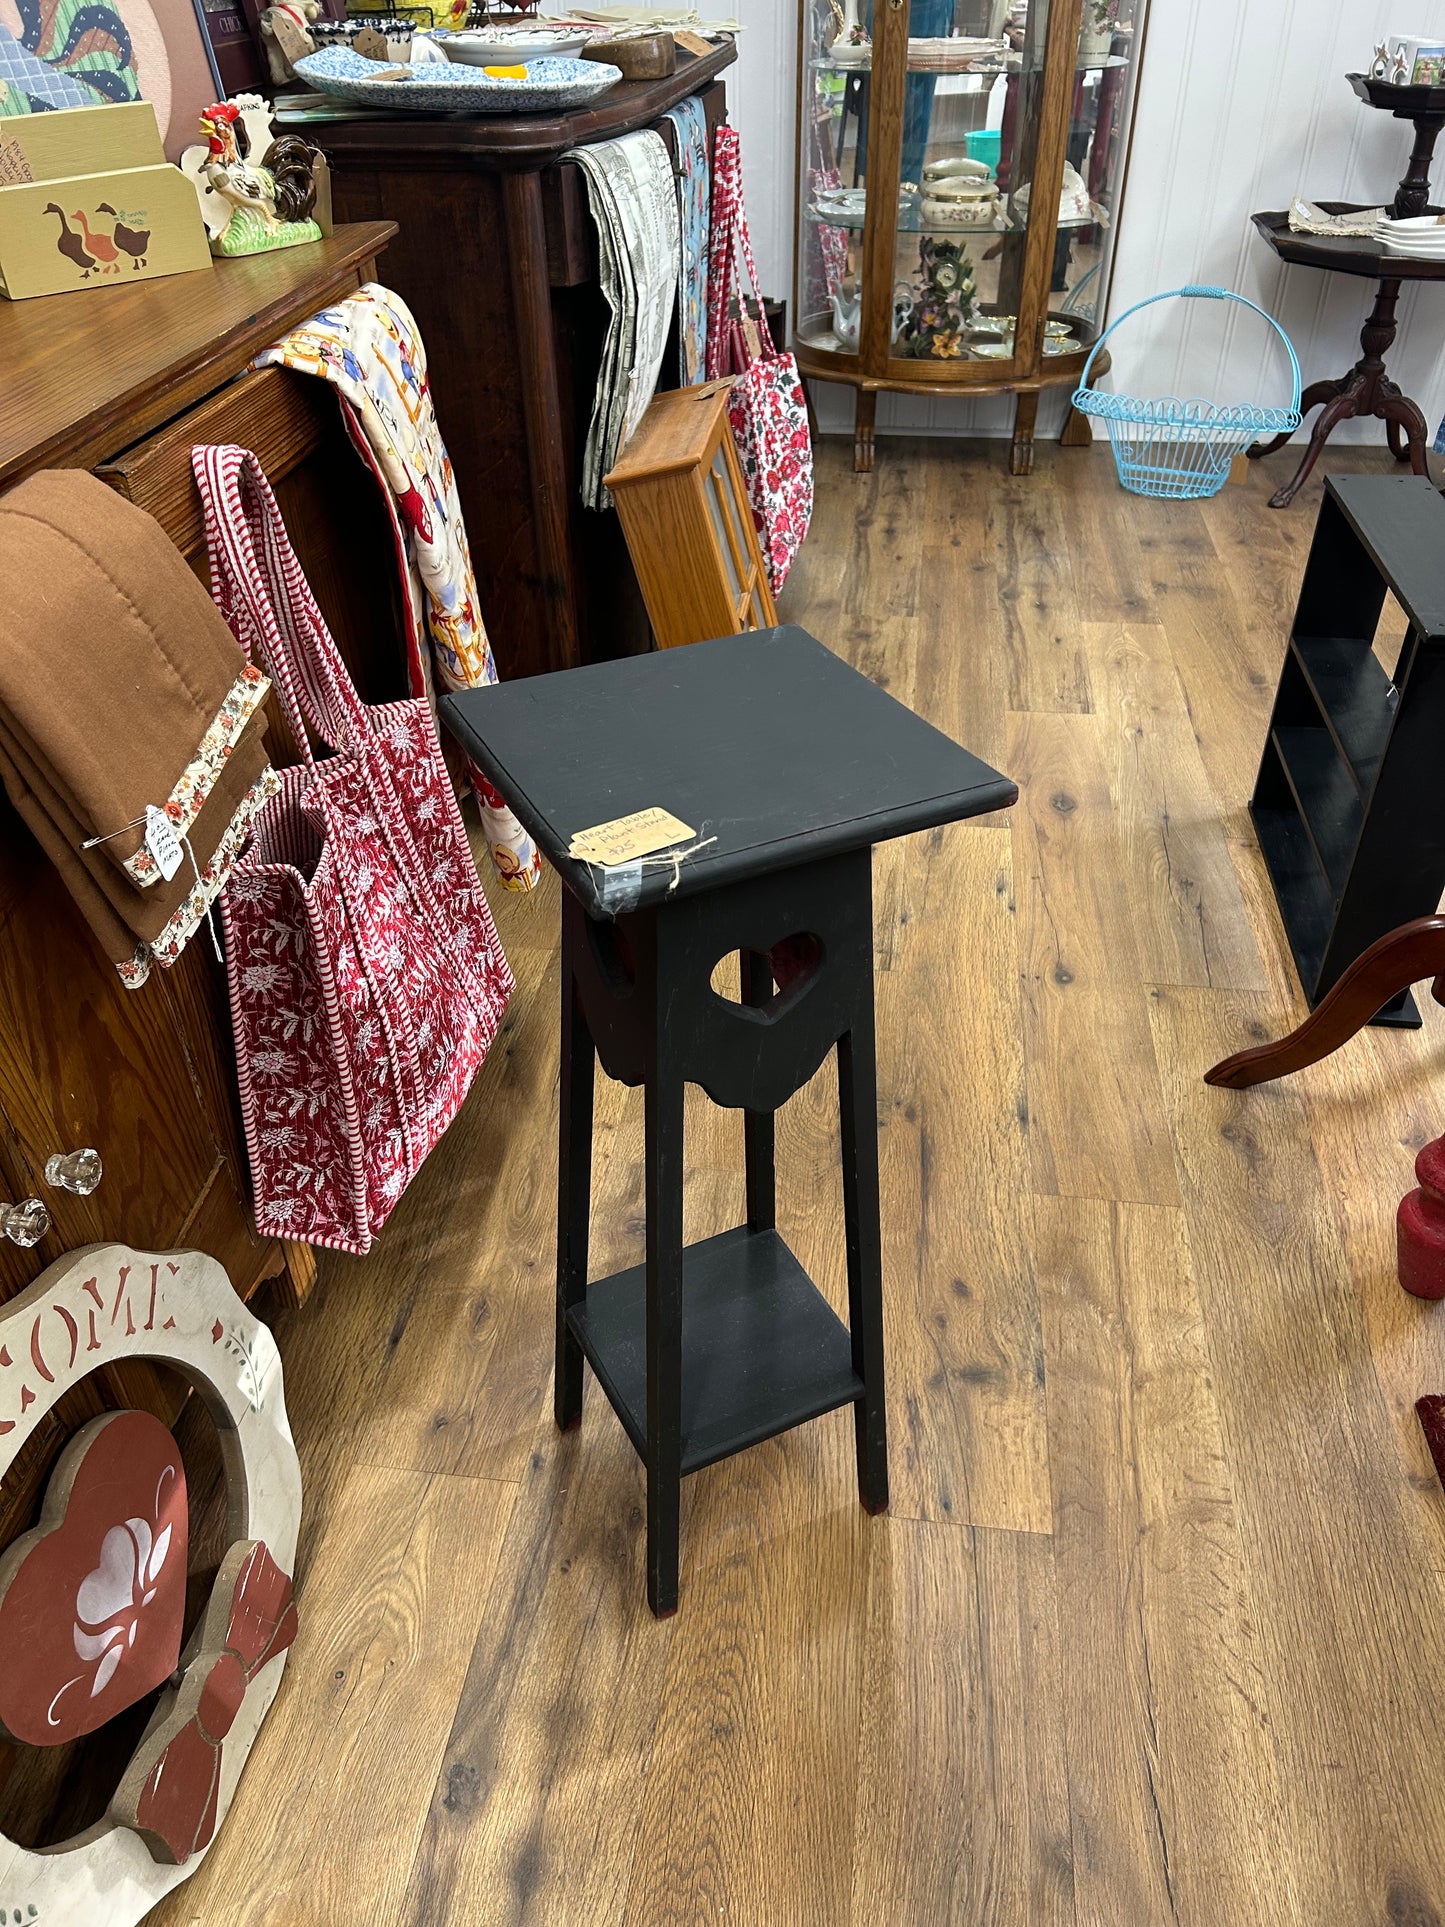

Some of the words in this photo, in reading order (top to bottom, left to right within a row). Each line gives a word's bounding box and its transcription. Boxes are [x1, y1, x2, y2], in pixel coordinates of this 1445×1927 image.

[238, 102, 260, 112] APKINS
[579, 823, 615, 841] Heart
[599, 828, 634, 844] Plant
[635, 814, 668, 830] Stand
[606, 839, 636, 856] $25
